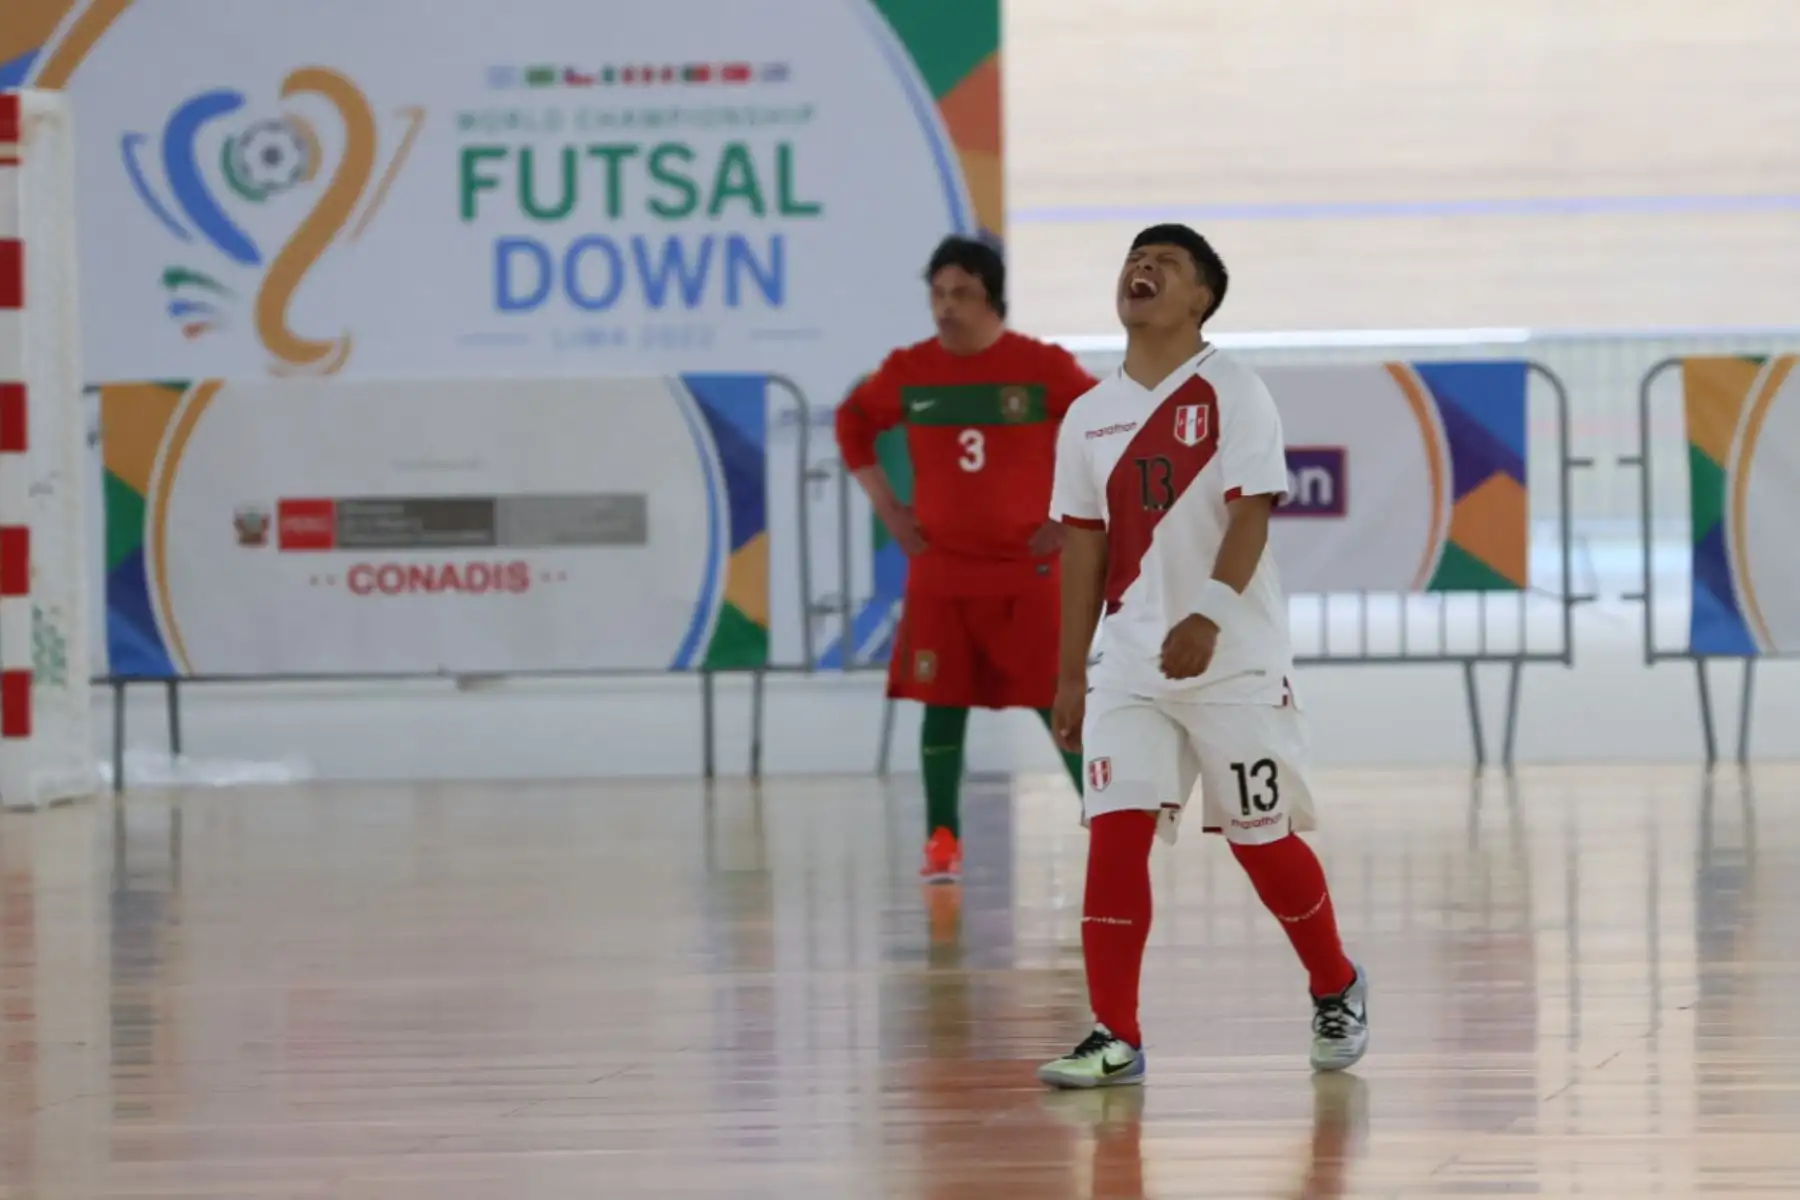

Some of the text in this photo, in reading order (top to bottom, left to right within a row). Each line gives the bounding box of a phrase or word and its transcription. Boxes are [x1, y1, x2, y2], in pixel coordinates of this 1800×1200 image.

[459, 142, 822, 221] FUTSAL
[494, 233, 786, 312] DOWN
[957, 428, 986, 473] 3
[1134, 454, 1175, 511] 13
[347, 561, 531, 596] CONADIS
[1230, 757, 1280, 816] 13
